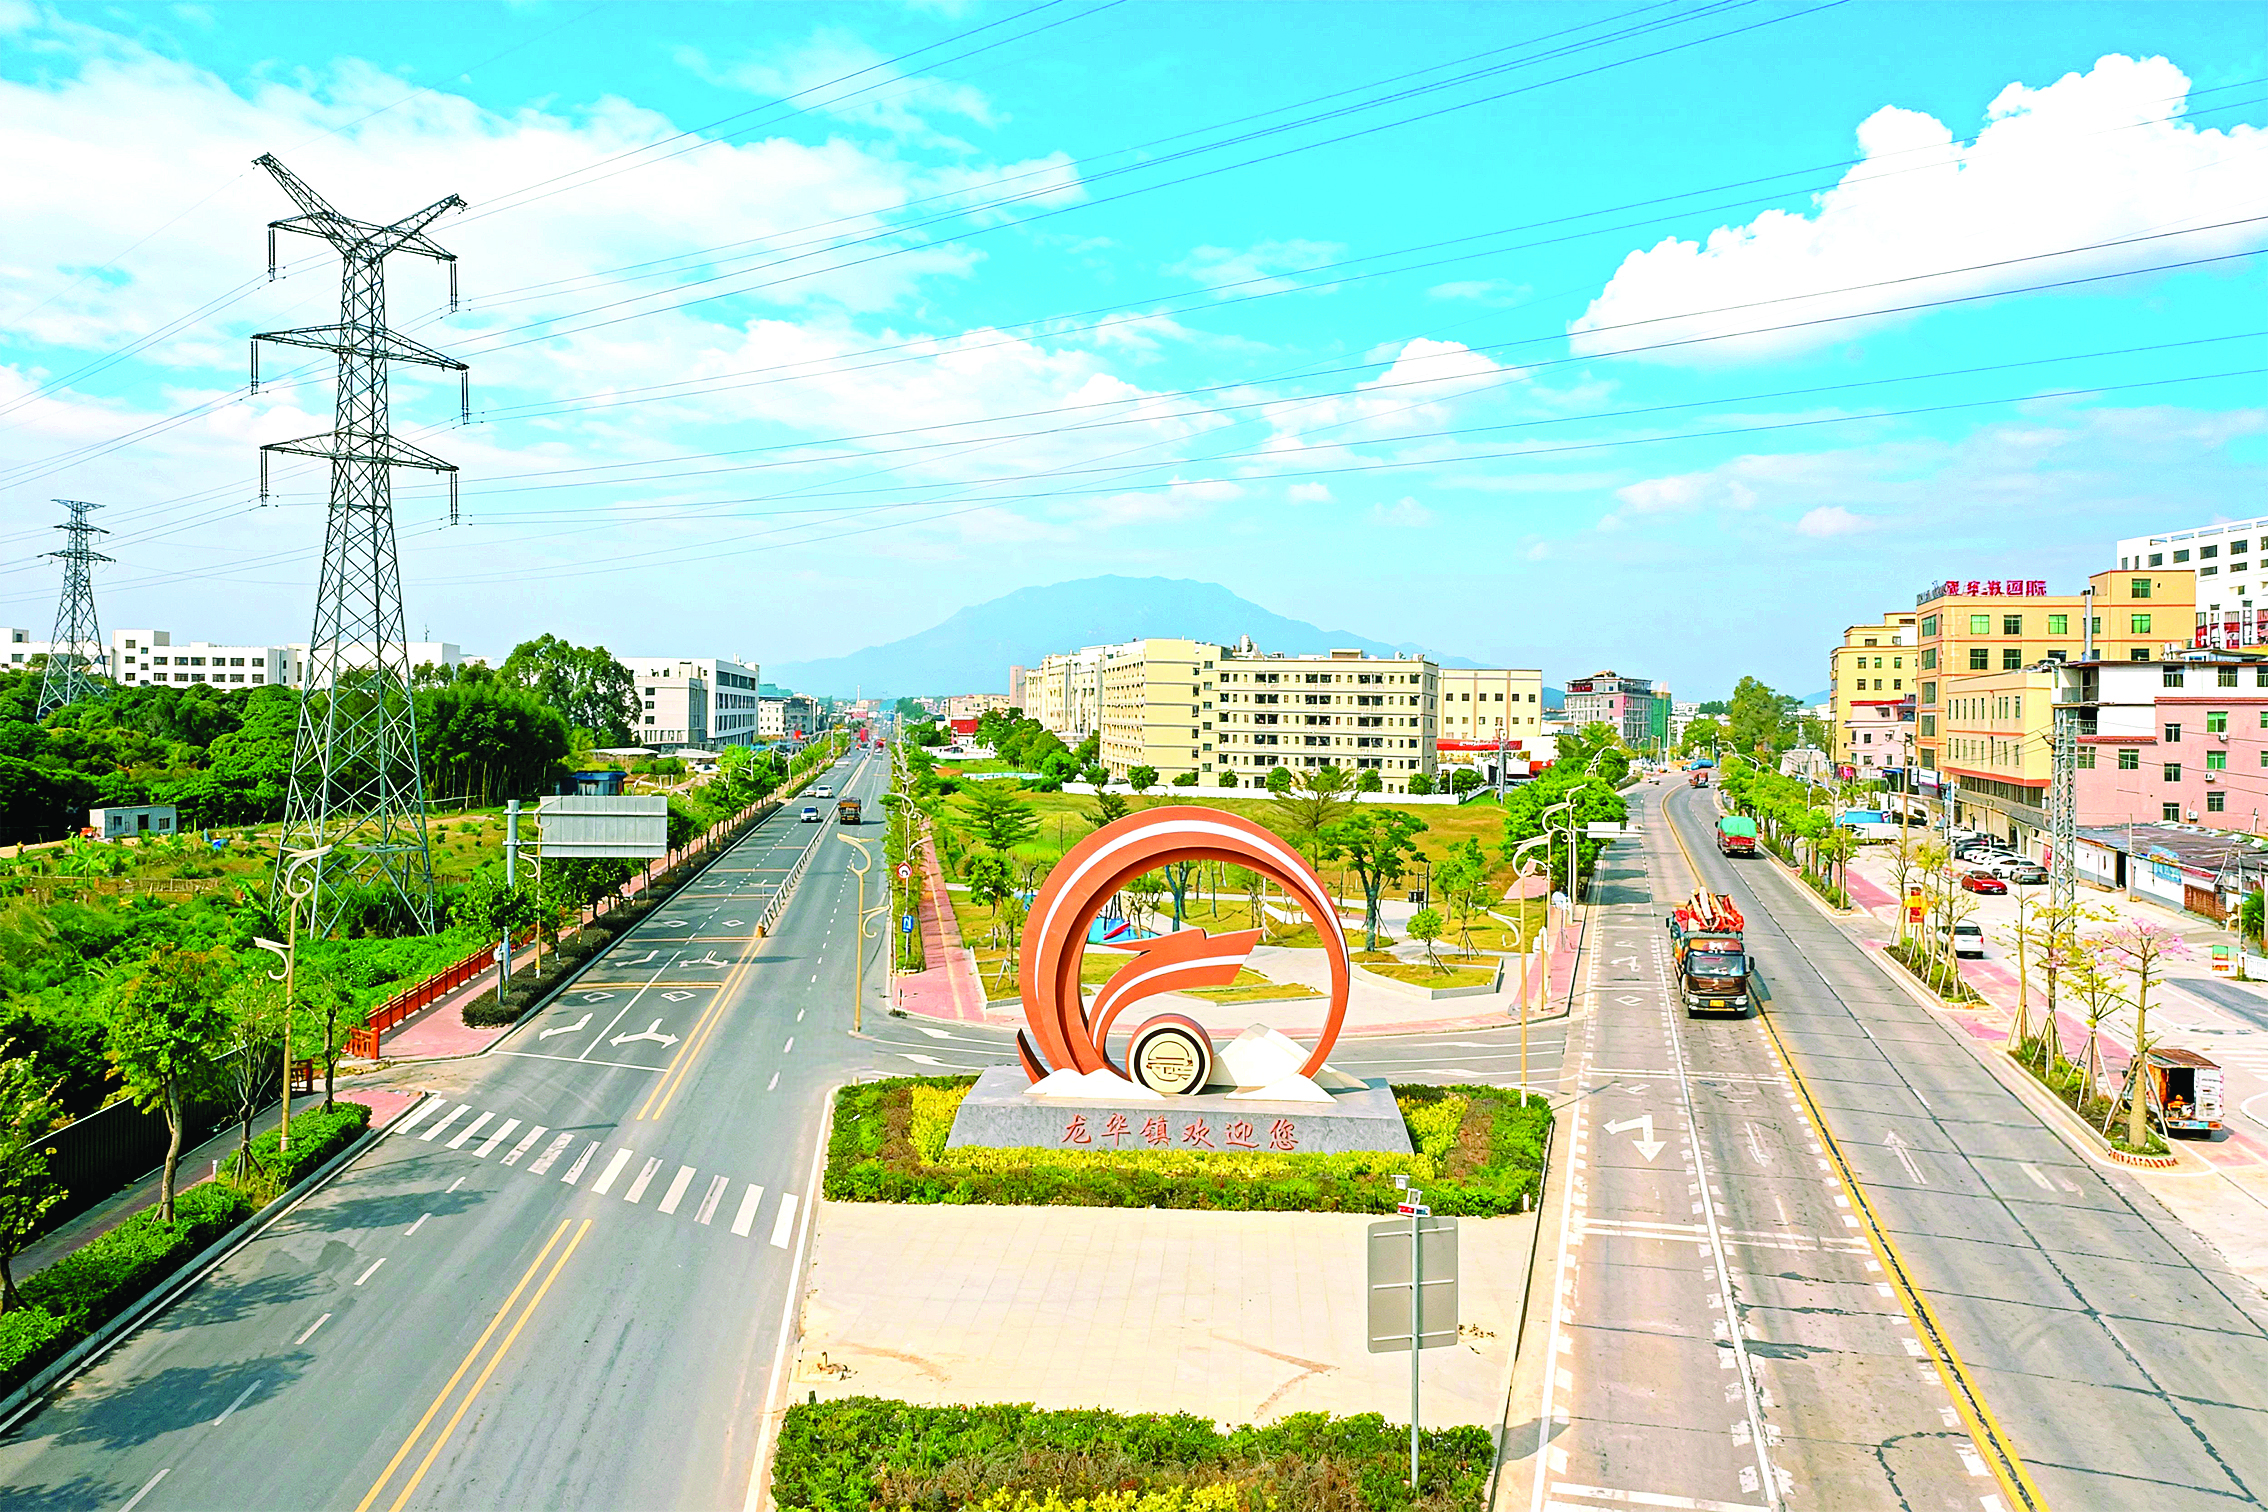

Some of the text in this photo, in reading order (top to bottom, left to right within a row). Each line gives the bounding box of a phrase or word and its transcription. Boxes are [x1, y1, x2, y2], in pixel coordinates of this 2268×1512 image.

[1061, 1112, 1300, 1151] 龙华镇欢迎您
